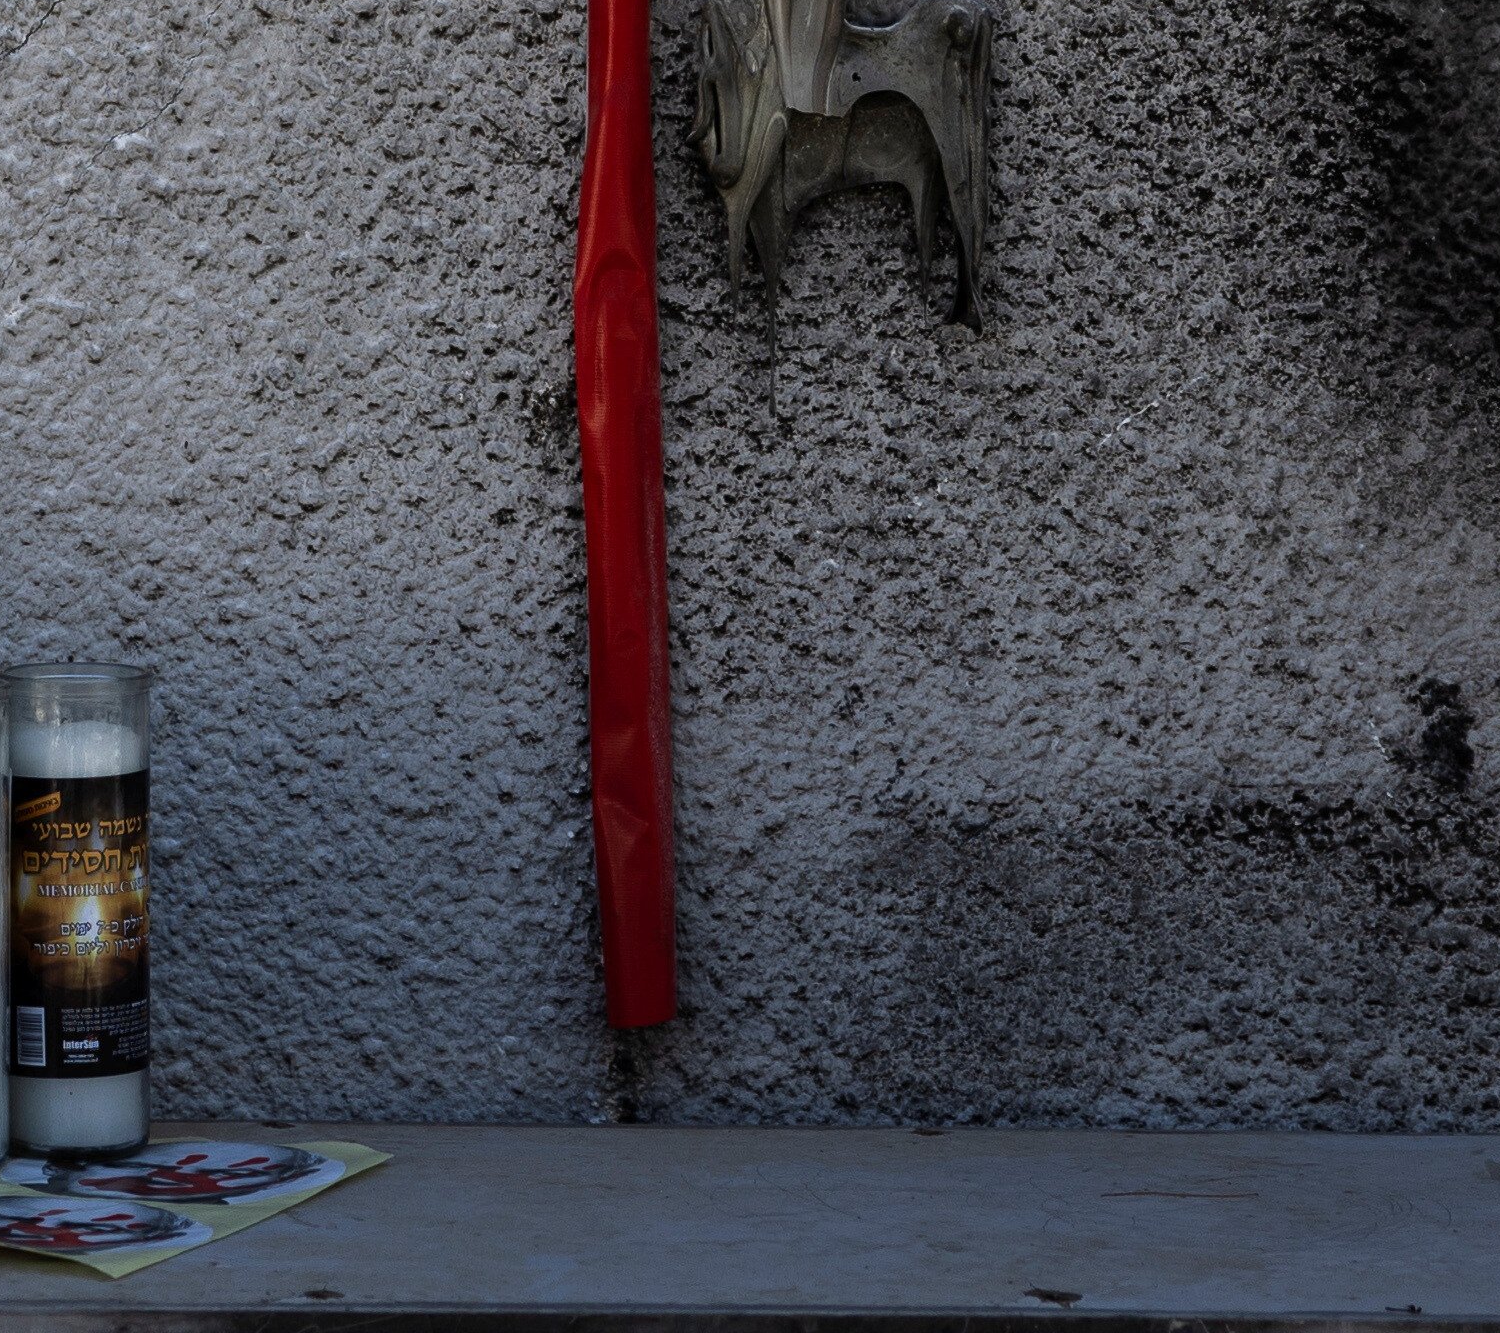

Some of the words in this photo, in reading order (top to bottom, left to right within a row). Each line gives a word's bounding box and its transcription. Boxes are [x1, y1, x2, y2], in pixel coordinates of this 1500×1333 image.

[32, 821, 91, 841] שבועי
[99, 815, 142, 837] נשמה
[23, 848, 122, 874] חסידים
[38, 882, 118, 897] MEMORIAL
[61, 922, 91, 936] ימים
[76, 936, 109, 955] וליום
